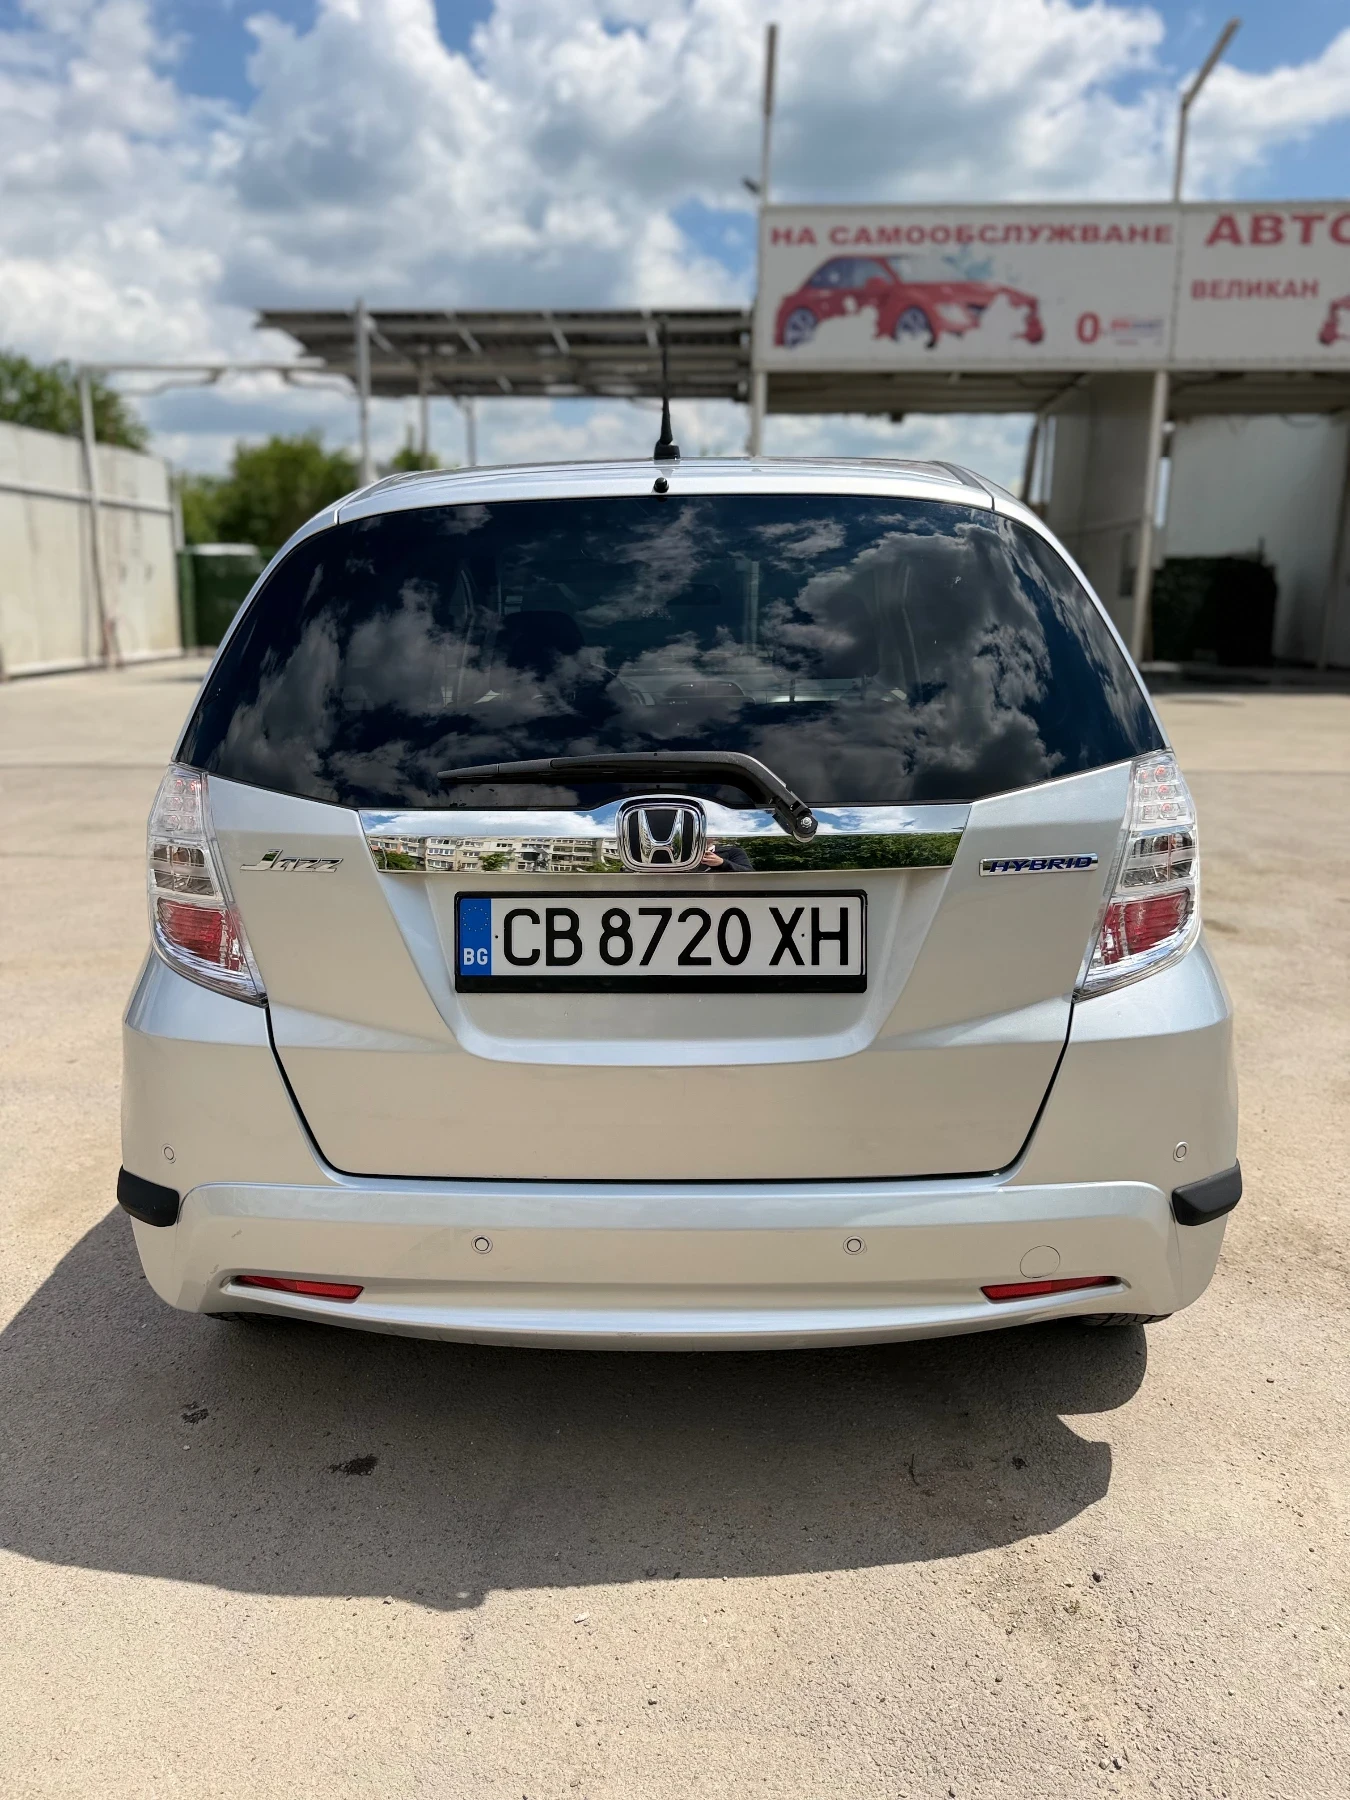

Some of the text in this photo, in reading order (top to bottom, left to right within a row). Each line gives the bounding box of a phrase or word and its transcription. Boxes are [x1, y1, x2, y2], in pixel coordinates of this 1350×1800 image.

[771, 223, 1173, 246] НА САМООБСЛУЖВАНЕ
[1190, 279, 1321, 300] ВЕЛИКАН
[239, 848, 344, 873] Jazz
[989, 856, 1094, 873] HYBRID
[503, 906, 849, 966] CB 8720 XH
[463, 947, 488, 966] BG
